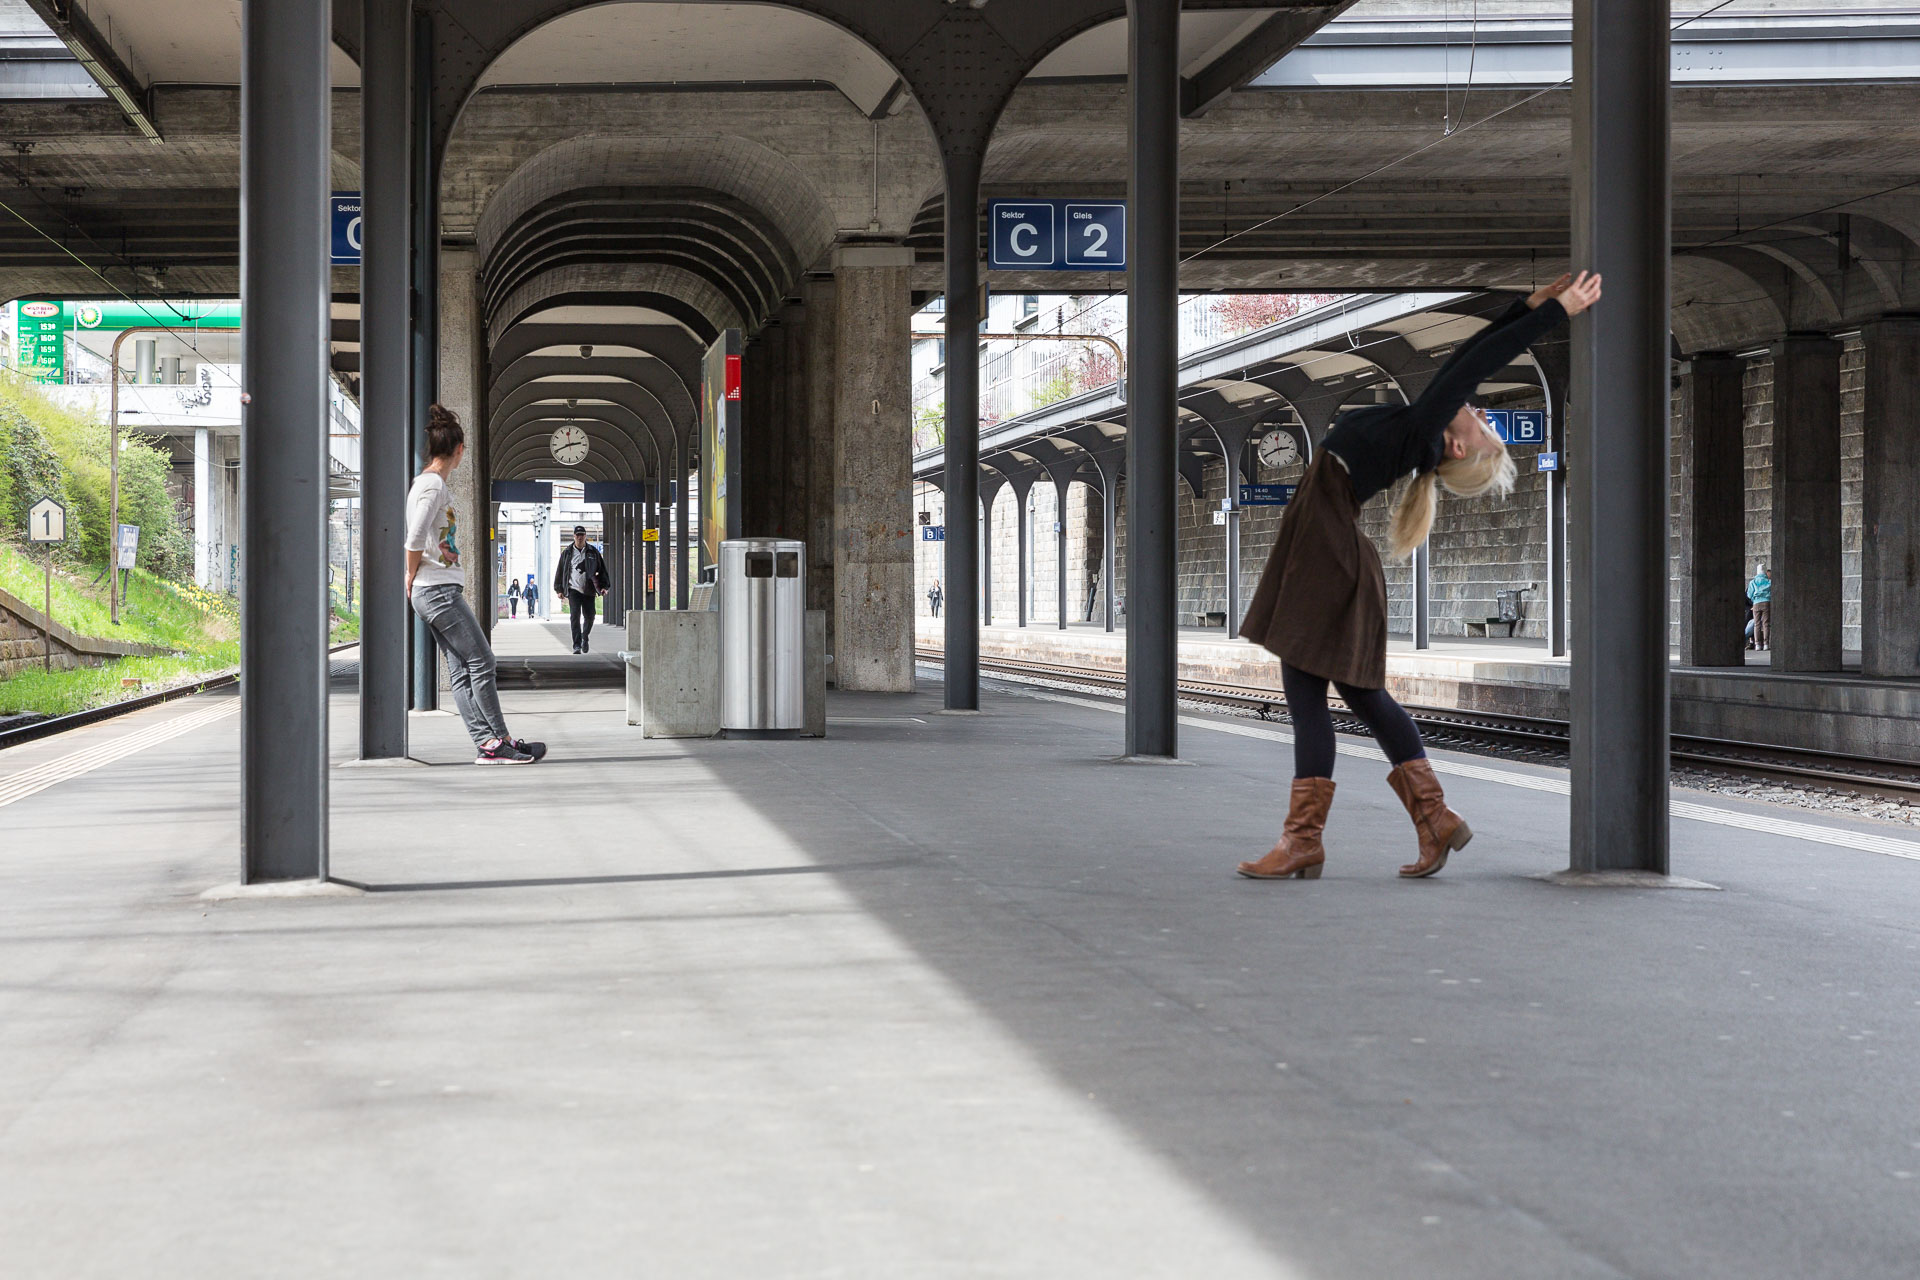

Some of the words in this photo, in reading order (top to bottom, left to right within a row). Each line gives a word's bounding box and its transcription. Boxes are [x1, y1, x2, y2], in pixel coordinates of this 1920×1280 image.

[1010, 223, 1038, 257] C
[1083, 223, 1108, 258] 2
[1521, 420, 1535, 438] B
[1243, 492, 1248, 500] 1
[42, 510, 50, 536] 1
[927, 531, 934, 539] B
